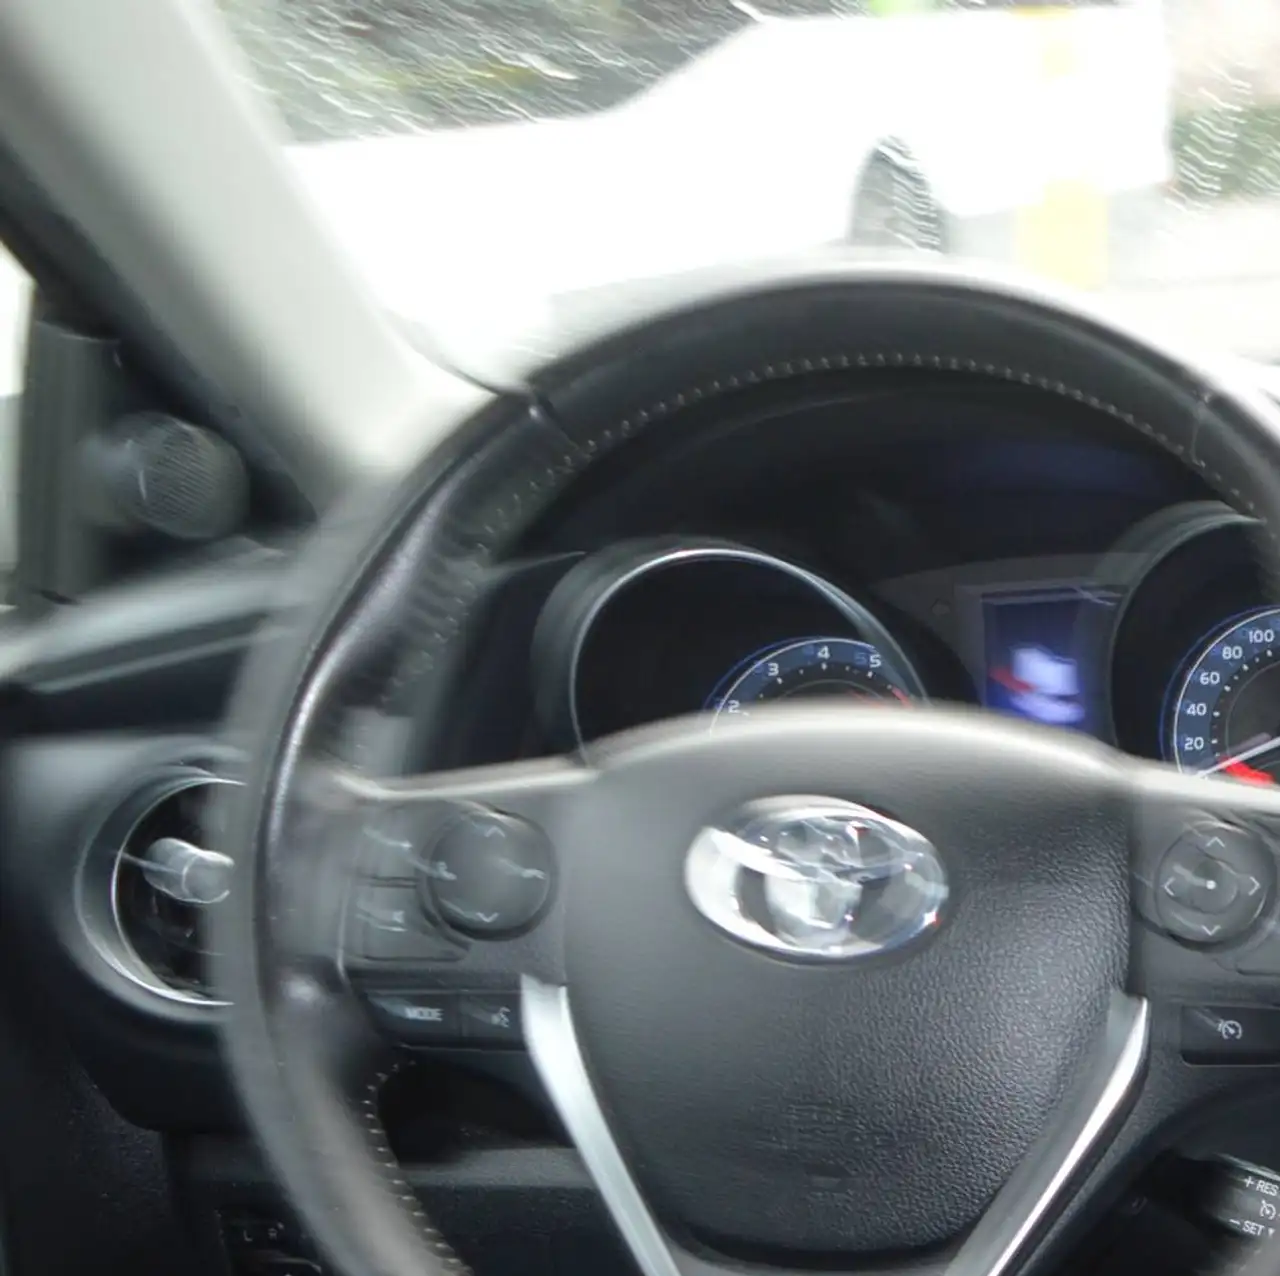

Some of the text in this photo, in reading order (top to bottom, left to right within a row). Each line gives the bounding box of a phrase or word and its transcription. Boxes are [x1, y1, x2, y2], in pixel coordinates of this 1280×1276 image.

[1248, 629, 1275, 643] 100
[817, 645, 831, 660] 4
[1222, 645, 1243, 659] 80
[869, 654, 882, 668] 5
[767, 662, 780, 676] 3
[1199, 671, 1221, 685] 60
[727, 699, 741, 714] 2
[1186, 703, 1208, 716] 40
[1184, 736, 1205, 750] 20
[404, 1005, 444, 1022] MODE
[1256, 1180, 1279, 1197] RES
[1241, 1220, 1266, 1237] SET
